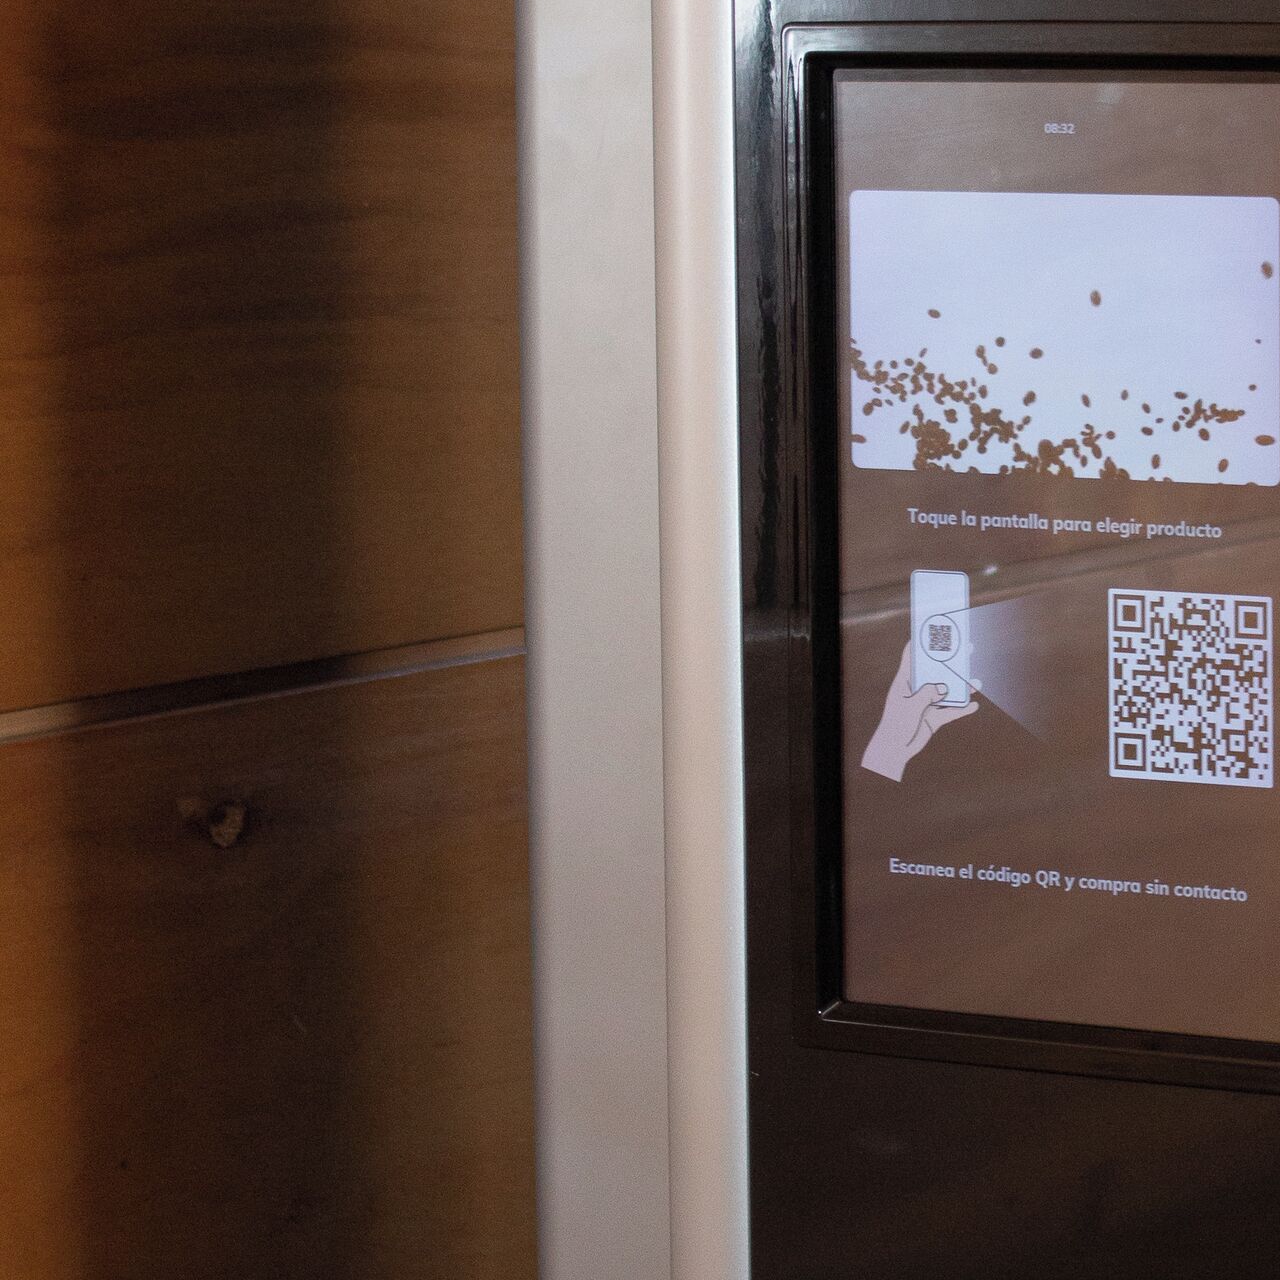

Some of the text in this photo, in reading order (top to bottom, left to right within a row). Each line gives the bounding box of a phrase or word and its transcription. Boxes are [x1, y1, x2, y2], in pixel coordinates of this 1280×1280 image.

[907, 507, 1223, 539] Toque la pantalla para elegir producto
[889, 858, 1249, 902] Escanea el código QR y compra sin contacto
